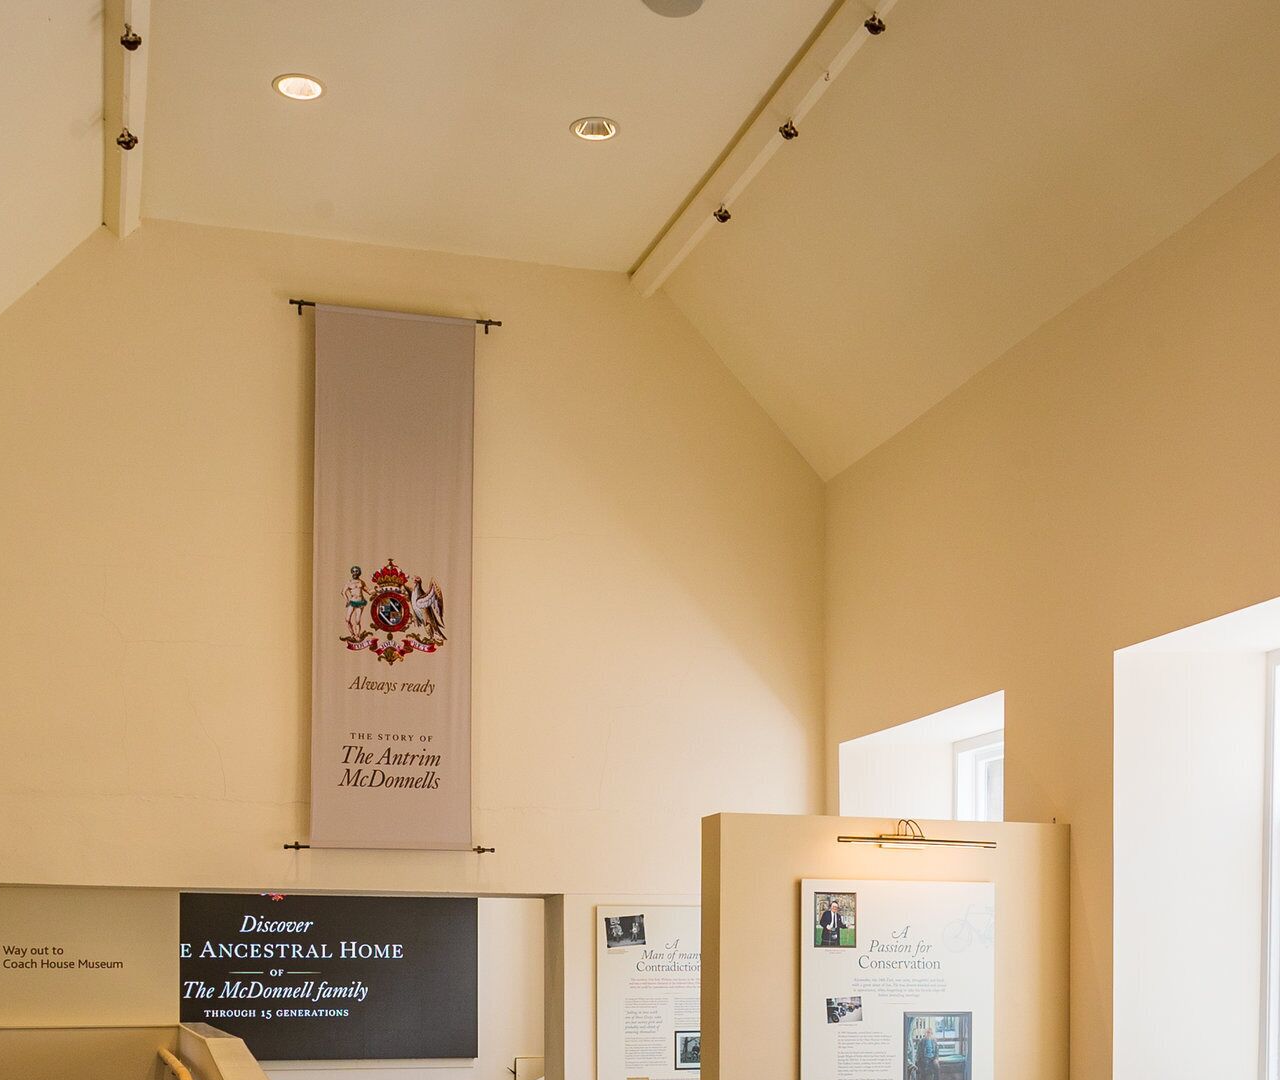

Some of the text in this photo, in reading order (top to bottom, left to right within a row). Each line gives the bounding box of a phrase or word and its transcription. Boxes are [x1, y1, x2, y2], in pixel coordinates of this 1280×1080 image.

[348, 675, 436, 696] Always ready
[350, 732, 374, 740] THE
[377, 733, 415, 742] STORY
[341, 745, 442, 767] The Antrim
[337, 768, 441, 790] McDonnells
[239, 915, 314, 933] Discover
[891, 925, 911, 939] A
[2, 945, 64, 958] Way out to
[199, 940, 334, 959] ANCESTRAL
[339, 941, 405, 959] HOME
[640, 949, 665, 960] Man
[666, 949, 678, 963] of
[869, 939, 933, 958] Passion for
[2, 959, 124, 969] Coach House Museum
[858, 955, 942, 970] Conservation
[269, 969, 285, 977] OF
[183, 981, 369, 1002] The McDonnell family
[204, 1009, 350, 1020] THROUGH 15 GENERATIONS
